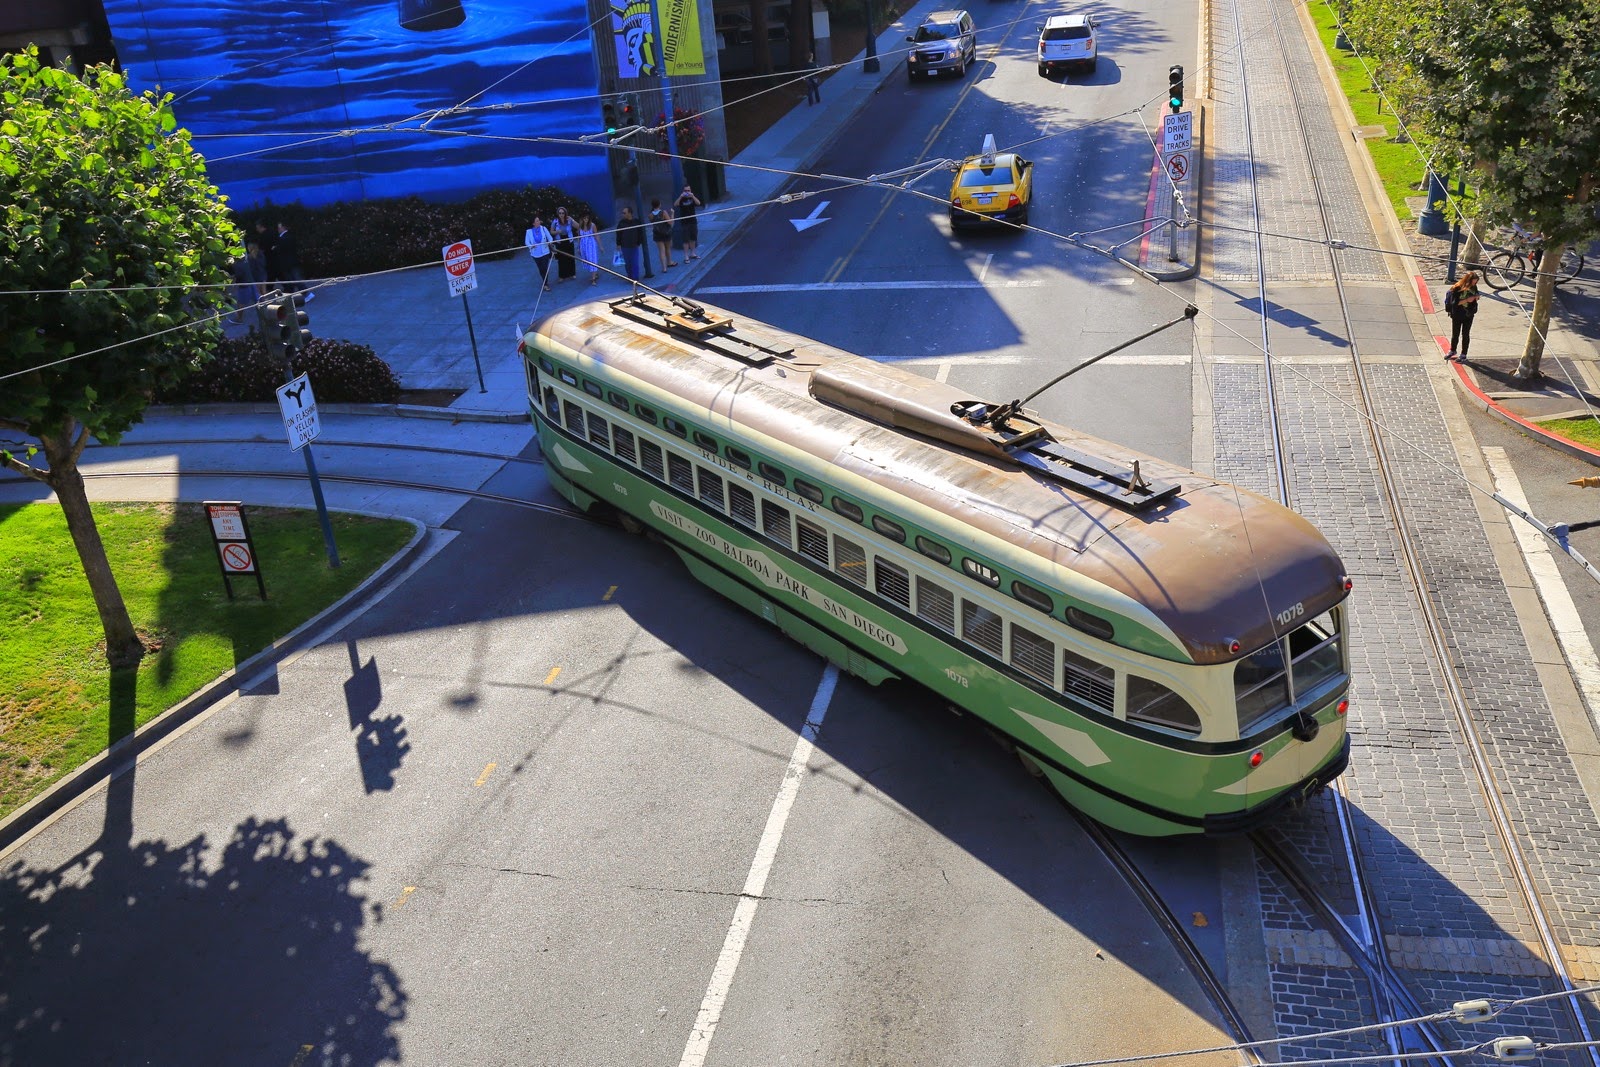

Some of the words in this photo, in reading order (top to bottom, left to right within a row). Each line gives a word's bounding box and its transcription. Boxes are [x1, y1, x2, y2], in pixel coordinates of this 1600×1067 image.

[664, 0, 685, 62] MODERNISM
[1167, 118, 1176, 126] DO
[1177, 115, 1189, 123] NOT
[1168, 124, 1188, 133] DRIVE
[1173, 133, 1184, 141] ON
[1167, 140, 1189, 150] TRACKS
[457, 247, 467, 255] NOT
[451, 261, 470, 272] ENTER
[455, 283, 473, 294] MUNI
[287, 417, 294, 427] ON
[295, 403, 316, 421] FLASHING
[295, 416, 314, 433] YELLOW
[299, 427, 314, 441] ONLY
[746, 472, 754, 482] &
[657, 505, 683, 528] VISIT
[695, 527, 716, 546] ZOO
[723, 542, 770, 578] BALBOA
[776, 571, 809, 600] PARK
[823, 598, 848, 620] SAN
[853, 614, 895, 648] DIEGO
[1277, 602, 1305, 626] 1078
[945, 667, 969, 689] 1078
